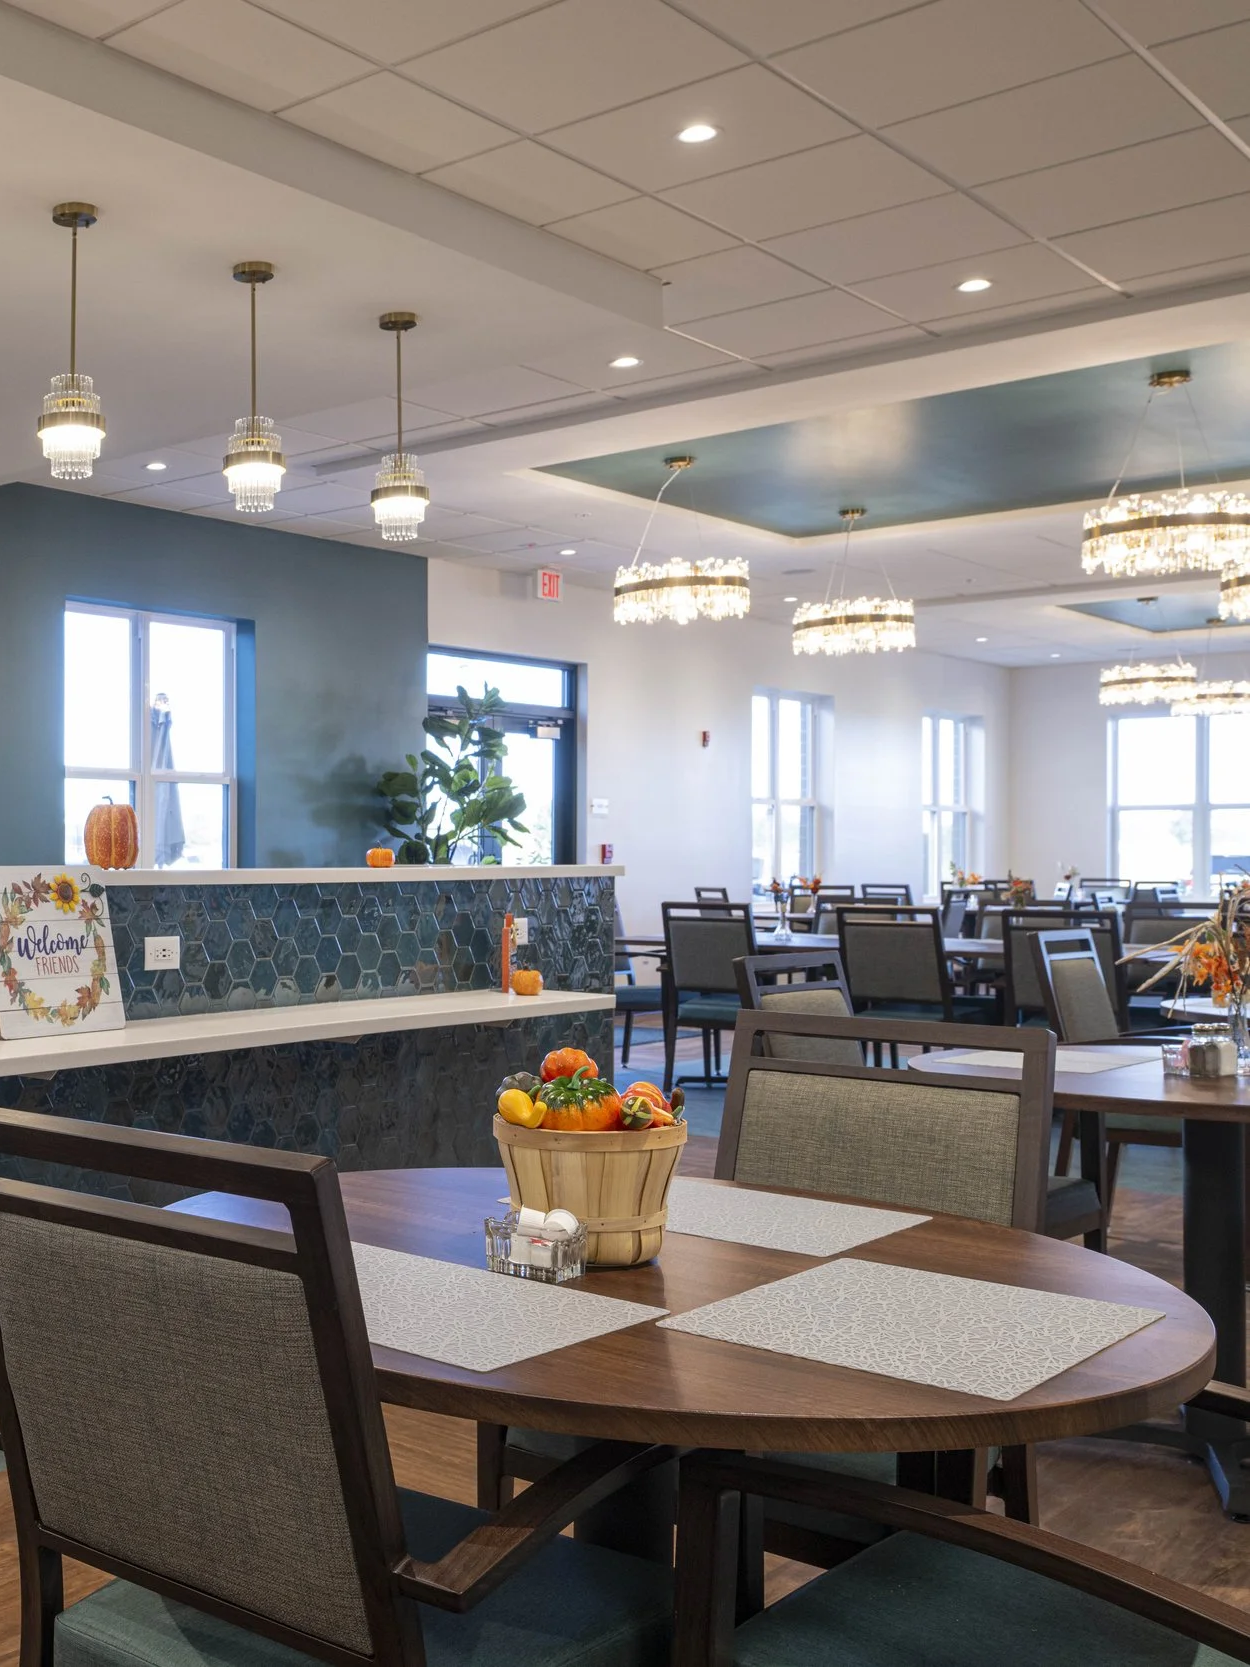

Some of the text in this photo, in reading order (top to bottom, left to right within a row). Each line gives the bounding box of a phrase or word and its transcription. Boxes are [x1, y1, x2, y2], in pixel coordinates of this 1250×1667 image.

[542, 572, 560, 599] EXIT
[17, 925, 89, 960] Welcome
[35, 955, 80, 976] FRIENDS
